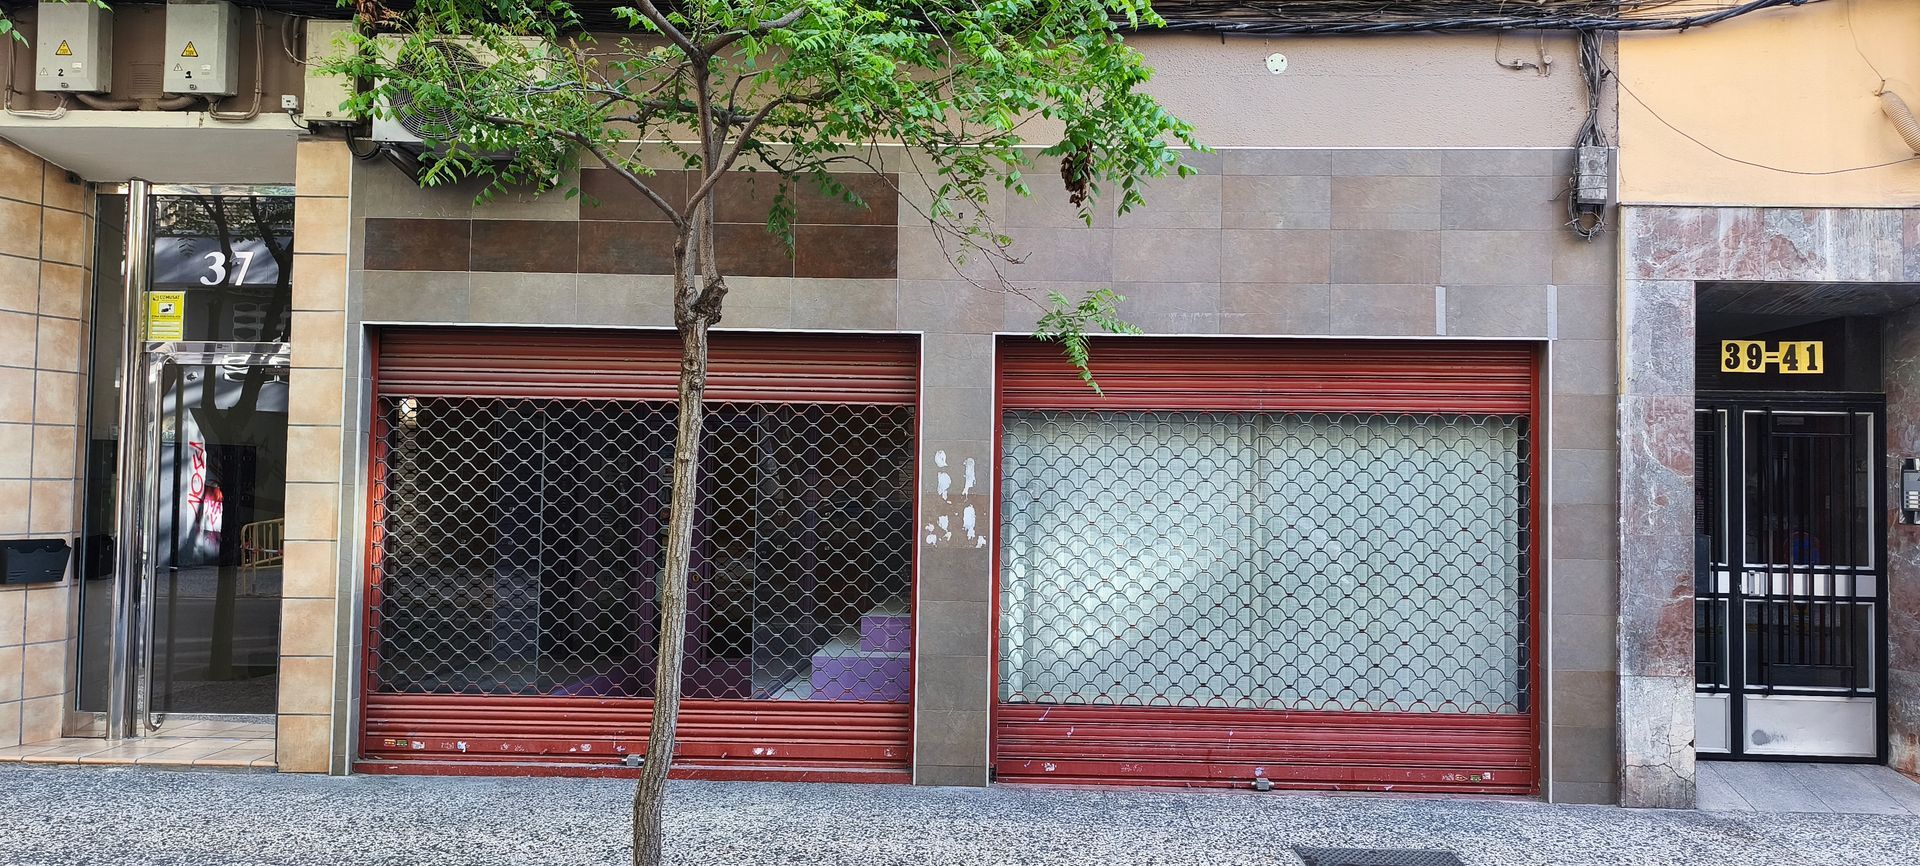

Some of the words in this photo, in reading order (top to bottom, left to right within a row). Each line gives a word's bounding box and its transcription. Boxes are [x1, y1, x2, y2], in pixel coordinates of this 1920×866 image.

[57, 68, 64, 77] 2
[185, 70, 192, 79] 1
[200, 251, 255, 286] 37
